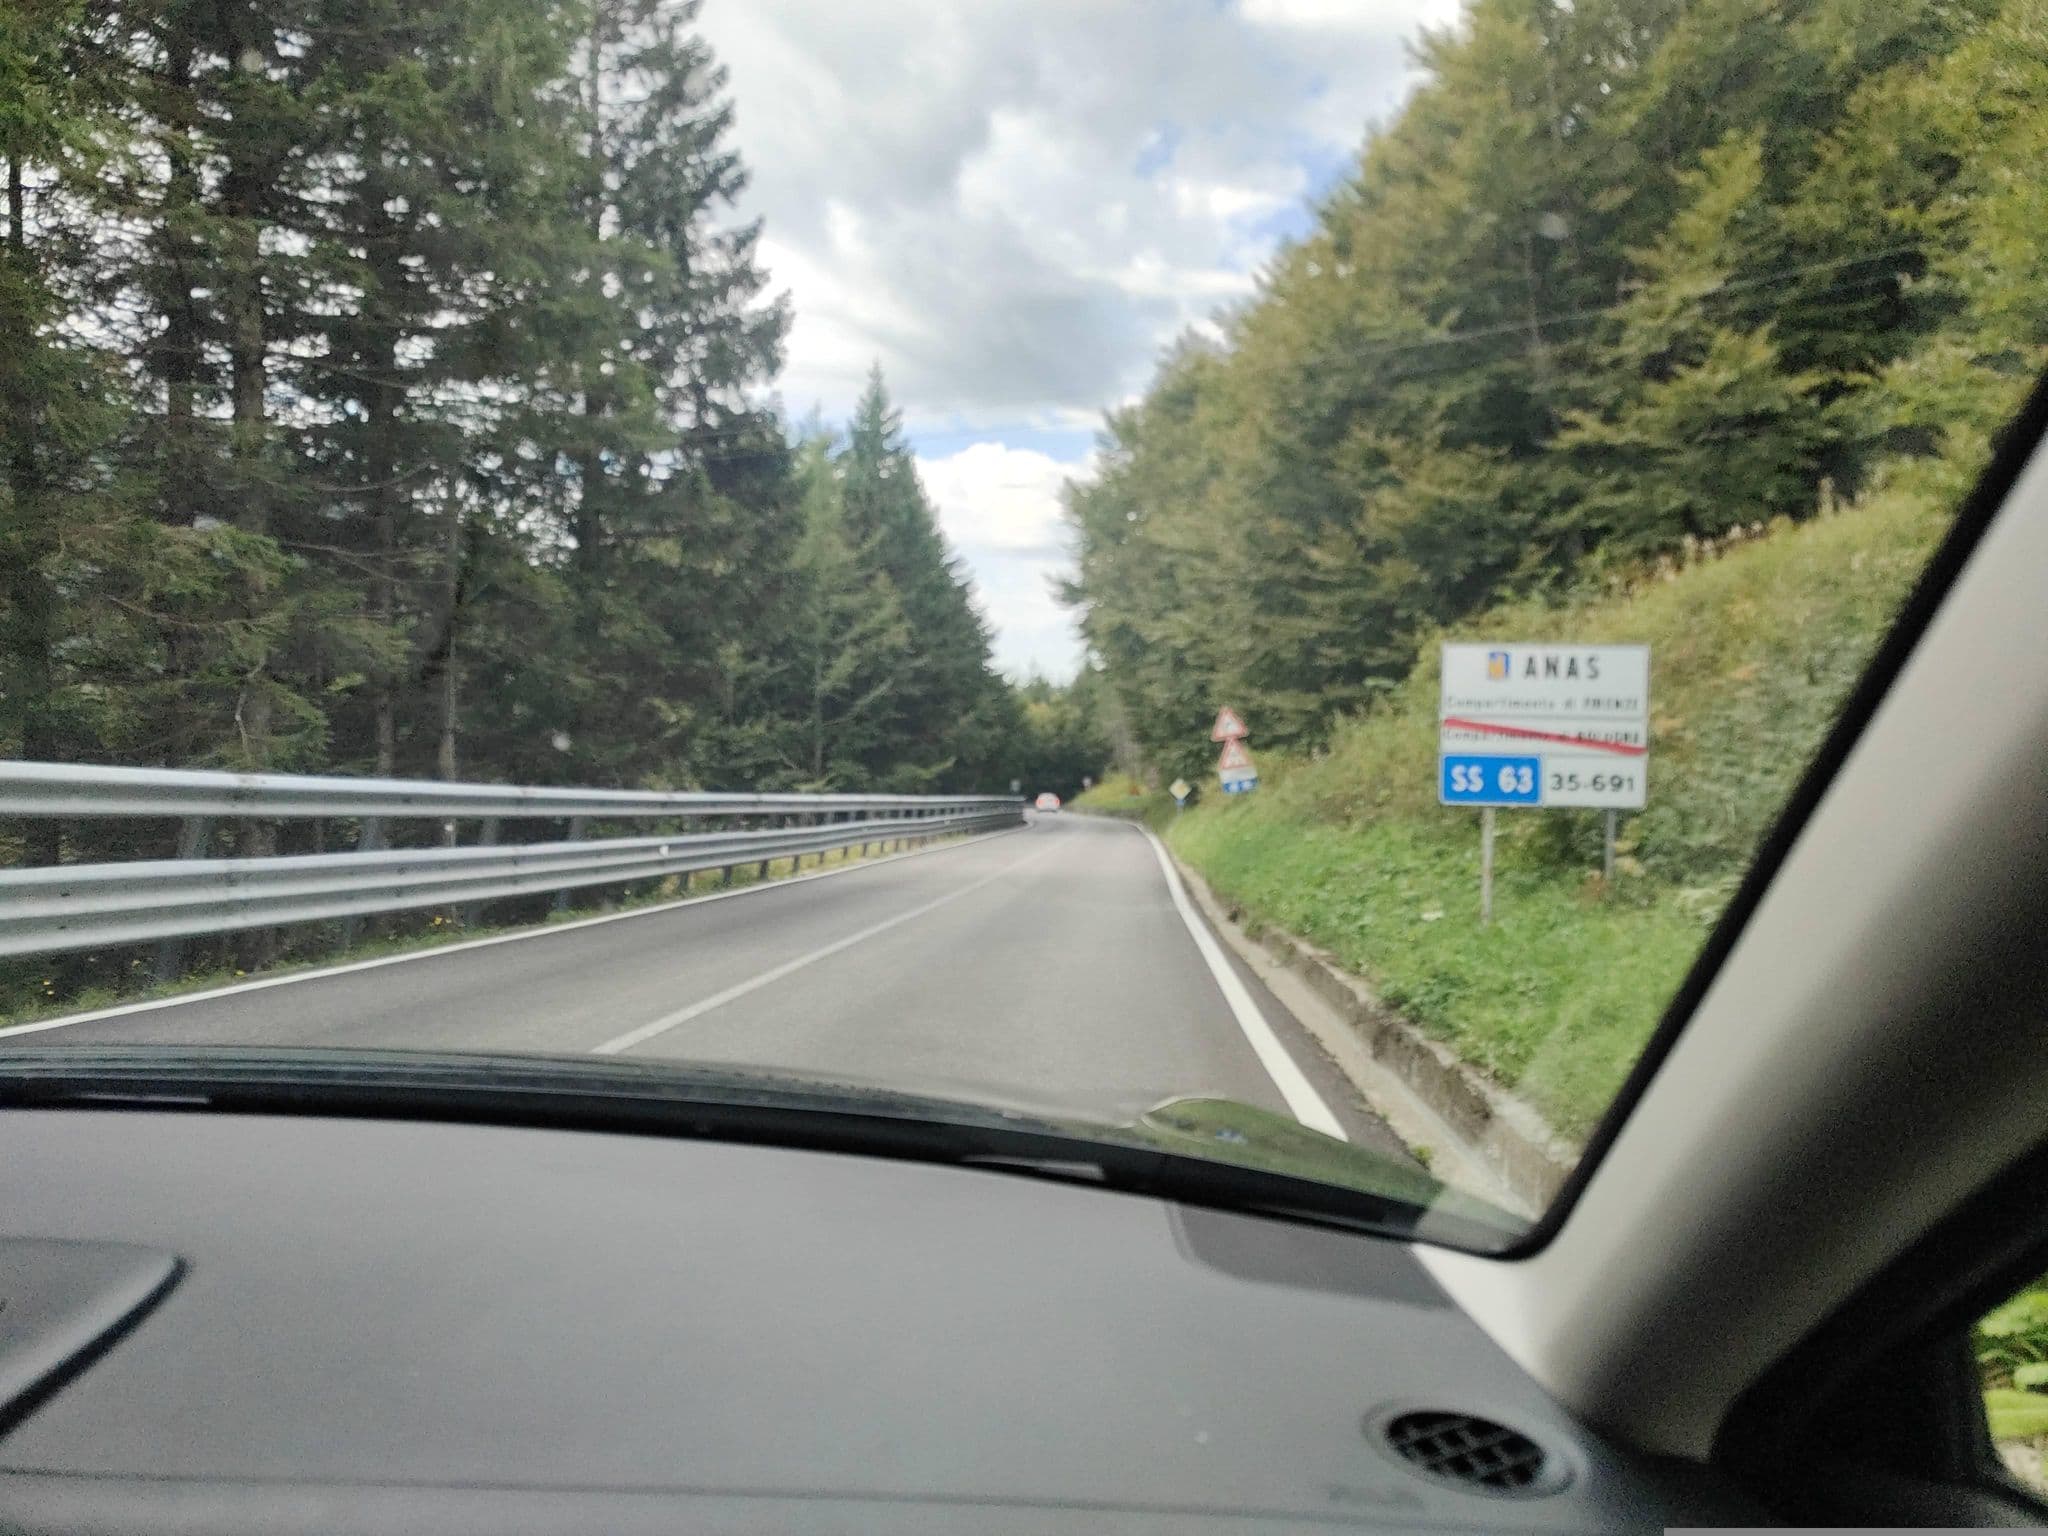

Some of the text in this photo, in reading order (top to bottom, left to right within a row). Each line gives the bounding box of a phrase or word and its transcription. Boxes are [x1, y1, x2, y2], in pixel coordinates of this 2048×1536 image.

[1524, 655, 1600, 680] ANAS
[1451, 764, 1535, 795] SS 63
